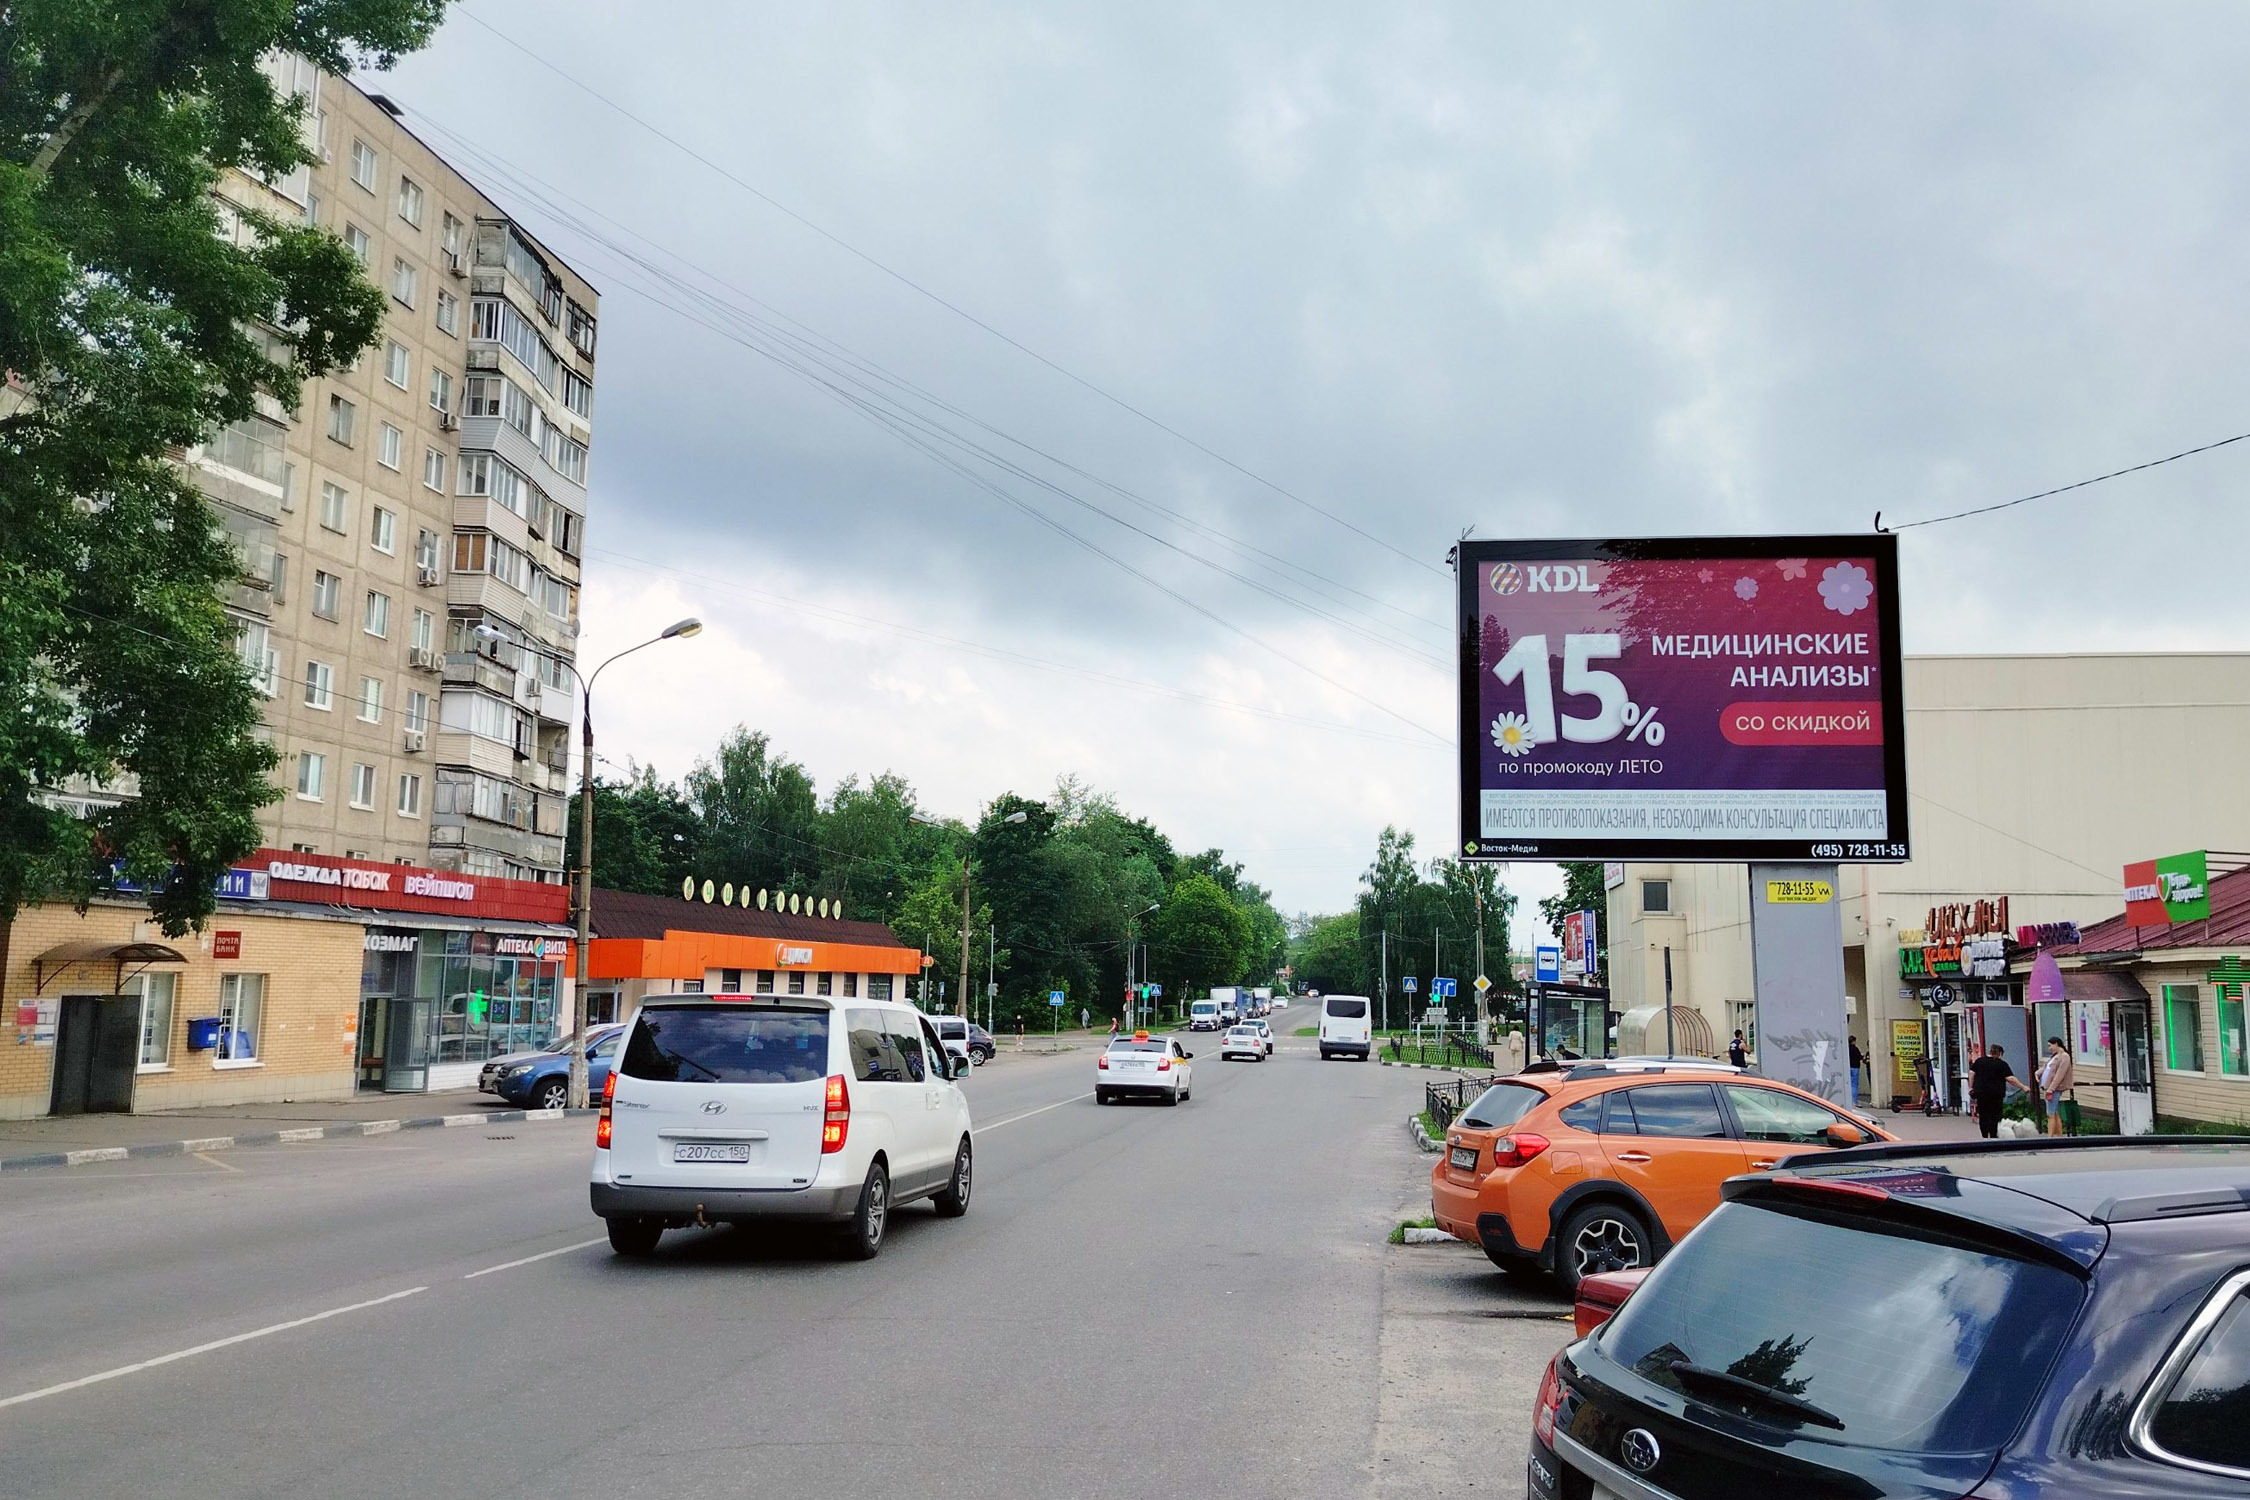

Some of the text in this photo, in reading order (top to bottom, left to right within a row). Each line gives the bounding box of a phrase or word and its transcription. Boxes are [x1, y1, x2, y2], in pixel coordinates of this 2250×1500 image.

[1527, 565, 1600, 593] KDL
[1652, 633, 1869, 658] МЕДИЦИНСКИЕ
[1499, 759, 1664, 777] по промокоду ЛЕТО
[1485, 808, 1886, 832] ИМЕЮТСЯ ПРОТИВОПОКАЗАНИЯ, НЕОБХОДИМА КОНСУЛЬТАЦИЯ СПЕЦИАЛИСТА
[1481, 843, 1539, 853] Восток-Медиа
[1811, 844, 1906, 857] (495) 728-11-55
[269, 861, 342, 886] ОДЕЖДА
[1777, 881, 1815, 896] 728-11-55
[216, 936, 239, 945] ПОЧТА
[496, 938, 567, 954] АПТЕКА ВИТА
[216, 945, 236, 953] БАНК
[1937, 989, 1950, 998] 24
[728, 1146, 746, 1157] 150
